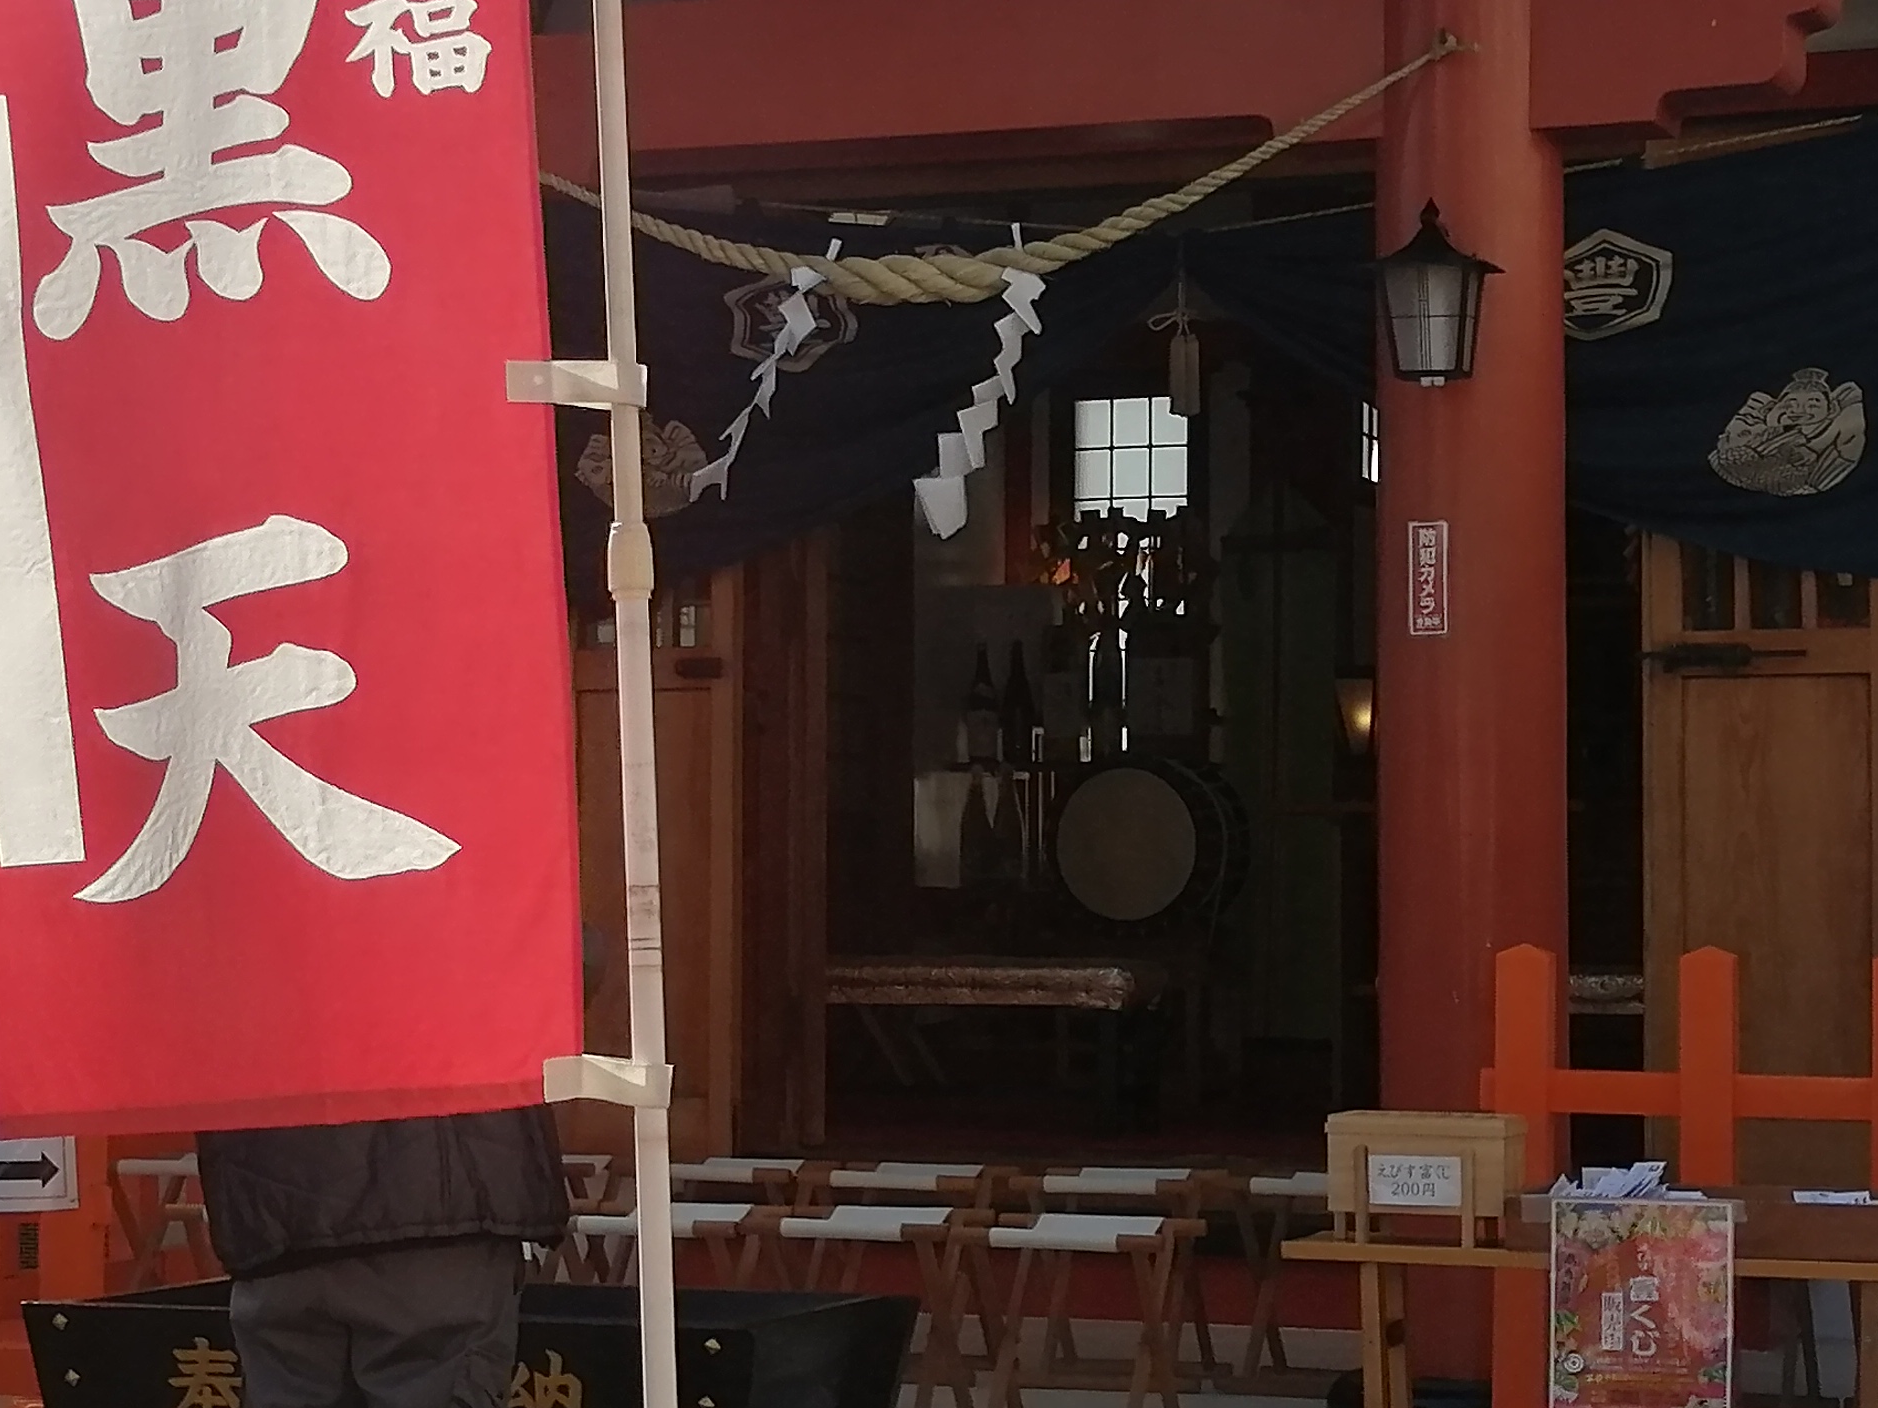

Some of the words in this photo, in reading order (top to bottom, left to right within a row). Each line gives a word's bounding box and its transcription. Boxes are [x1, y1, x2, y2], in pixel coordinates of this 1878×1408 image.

[1417, 527, 1437, 614] 防犯カメラ
[1377, 1163, 1451, 1180] えびす富くじ
[1391, 1182, 1436, 1198] 200円
